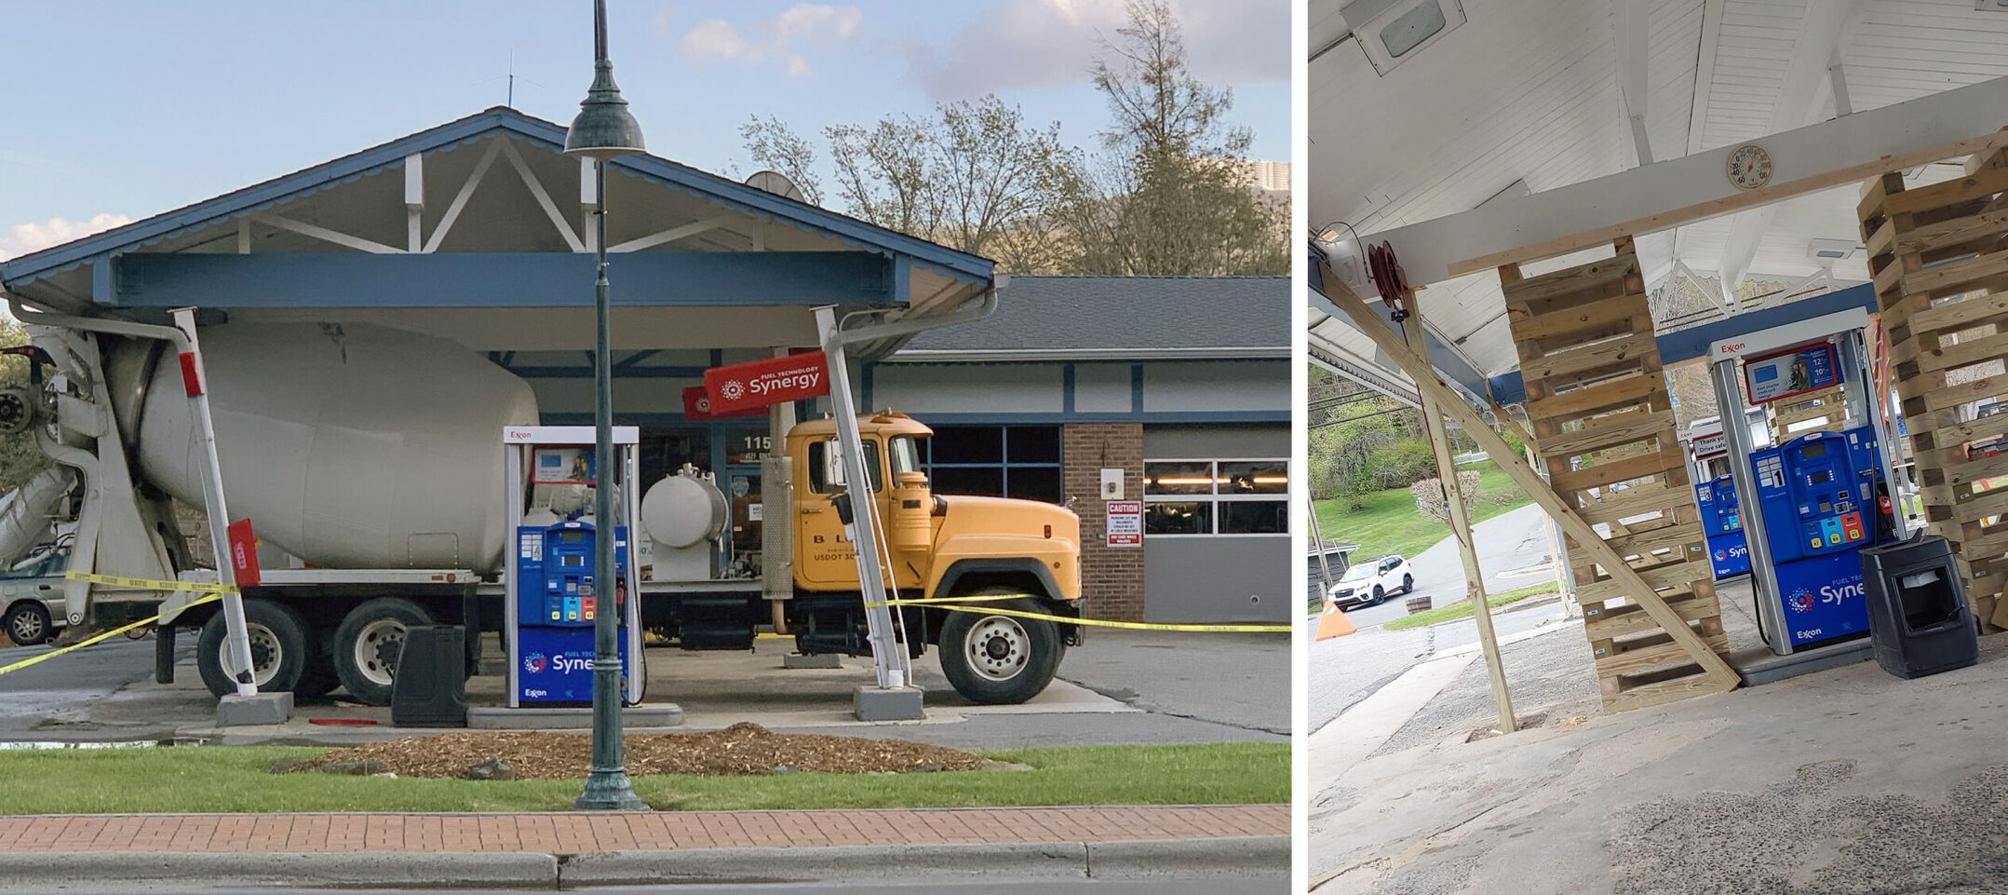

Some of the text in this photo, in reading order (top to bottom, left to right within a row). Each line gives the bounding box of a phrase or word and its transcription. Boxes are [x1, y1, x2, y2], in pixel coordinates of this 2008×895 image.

[1721, 342, 1746, 353] Exxon
[778, 366, 819, 377] TECHNOLOGY
[749, 372, 820, 395] Synergy
[511, 431, 532, 440] Exxon
[744, 436, 771, 449] 115
[1110, 504, 1138, 513] CAUTION
[814, 535, 824, 543] B
[1832, 577, 1850, 586] FUEL
[1820, 582, 1865, 606] Syne
[1797, 628, 1822, 639] Exxon
[552, 655, 594, 675] Syne
[525, 688, 547, 698] Exxon
